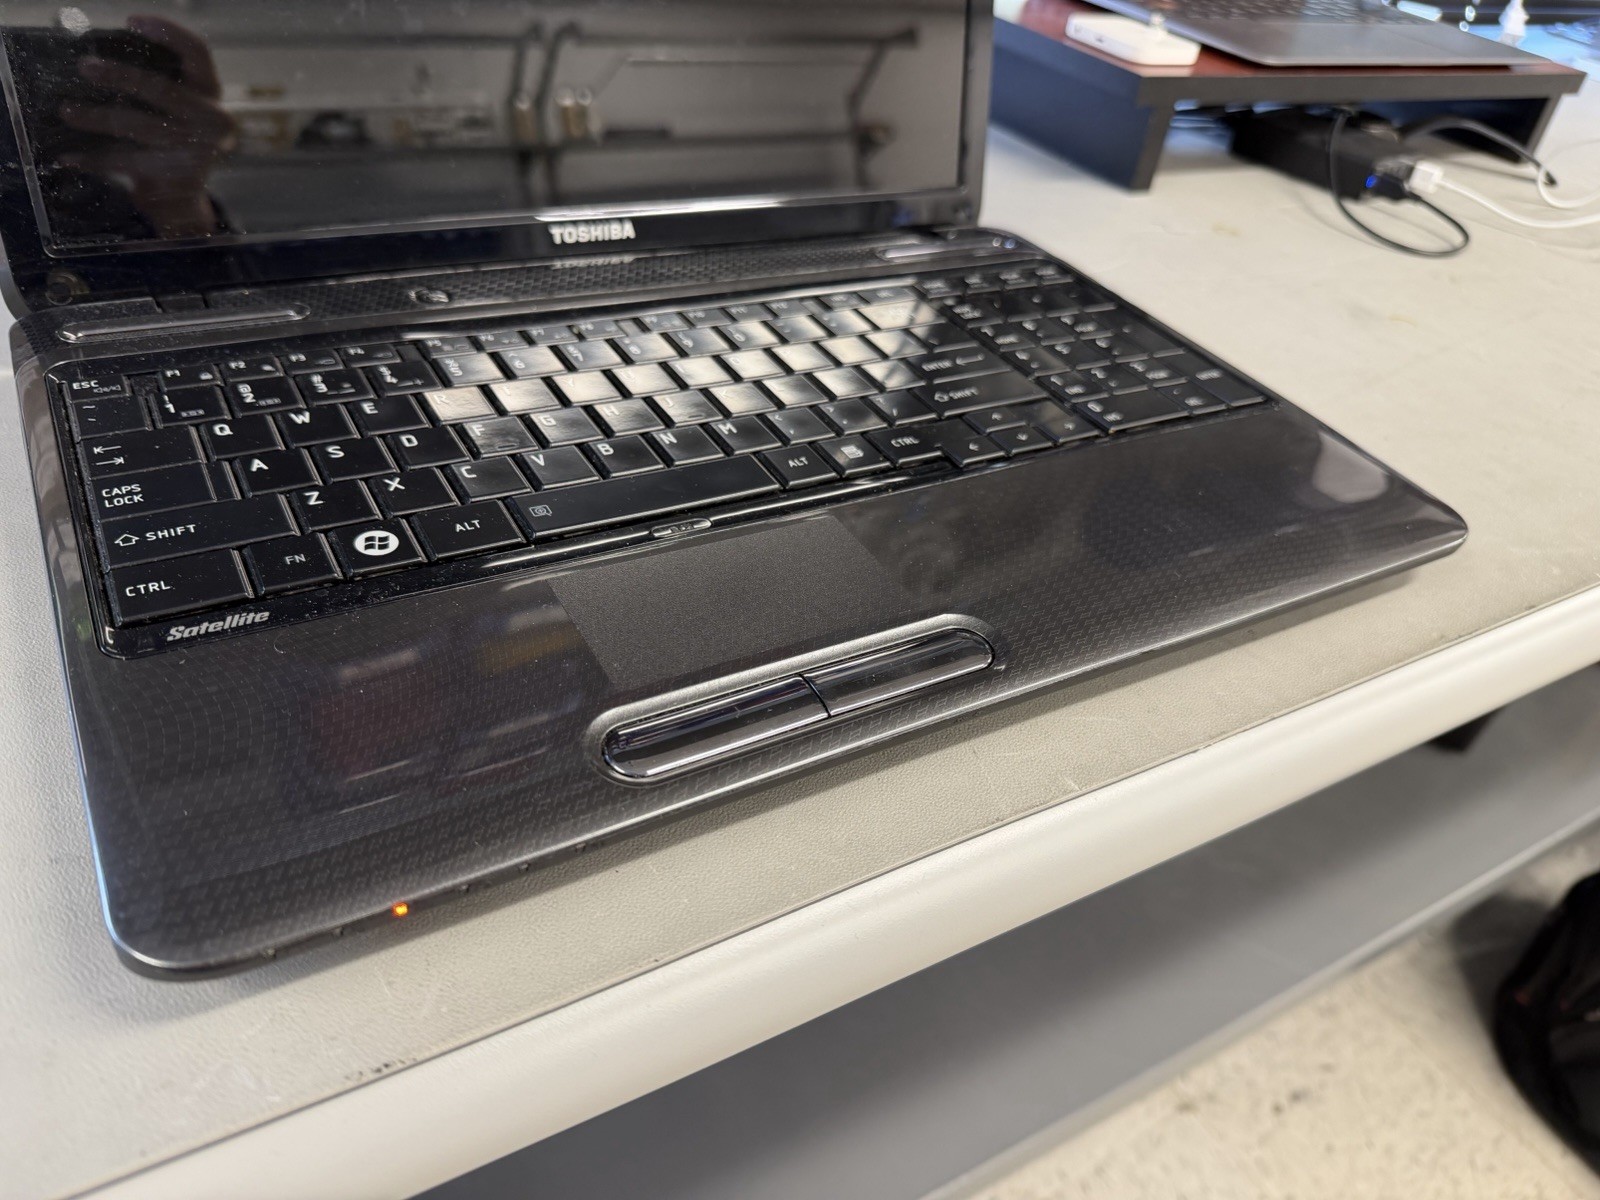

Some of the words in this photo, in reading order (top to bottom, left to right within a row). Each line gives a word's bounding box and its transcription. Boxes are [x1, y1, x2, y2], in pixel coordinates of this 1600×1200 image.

[548, 218, 636, 245] TOSHIBA
[287, 353, 306, 362] F3
[514, 360, 526, 369] 6
[228, 361, 246, 370] F2
[450, 367, 463, 377] 5
[921, 359, 953, 372] ENTER
[165, 369, 181, 378] F1
[72, 380, 99, 390] ESC
[313, 382, 328, 393] 3
[242, 392, 257, 404] 2
[948, 386, 979, 400] SHIFT
[164, 402, 175, 413] 1
[361, 401, 379, 415] E
[602, 403, 621, 417] H
[288, 411, 310, 425] W
[539, 414, 557, 427] G
[213, 423, 233, 436] Q
[471, 423, 487, 437] F
[717, 422, 738, 435] M
[400, 434, 419, 448] D
[658, 432, 679, 445] N
[890, 434, 920, 448] CTRL
[325, 445, 345, 459] S
[597, 442, 614, 456] B
[250, 458, 269, 472] A
[529, 453, 545, 467] V
[788, 456, 809, 468] ALT
[460, 465, 478, 479] C
[101, 483, 143, 498] CAPS
[383, 477, 406, 492] X
[103, 493, 145, 509] LOCK
[303, 490, 324, 506] Z
[454, 518, 482, 533] ALT
[145, 523, 198, 543] SHIFT
[284, 553, 307, 566] FN
[124, 580, 171, 598] CTRL
[166, 609, 271, 642] Satellite
